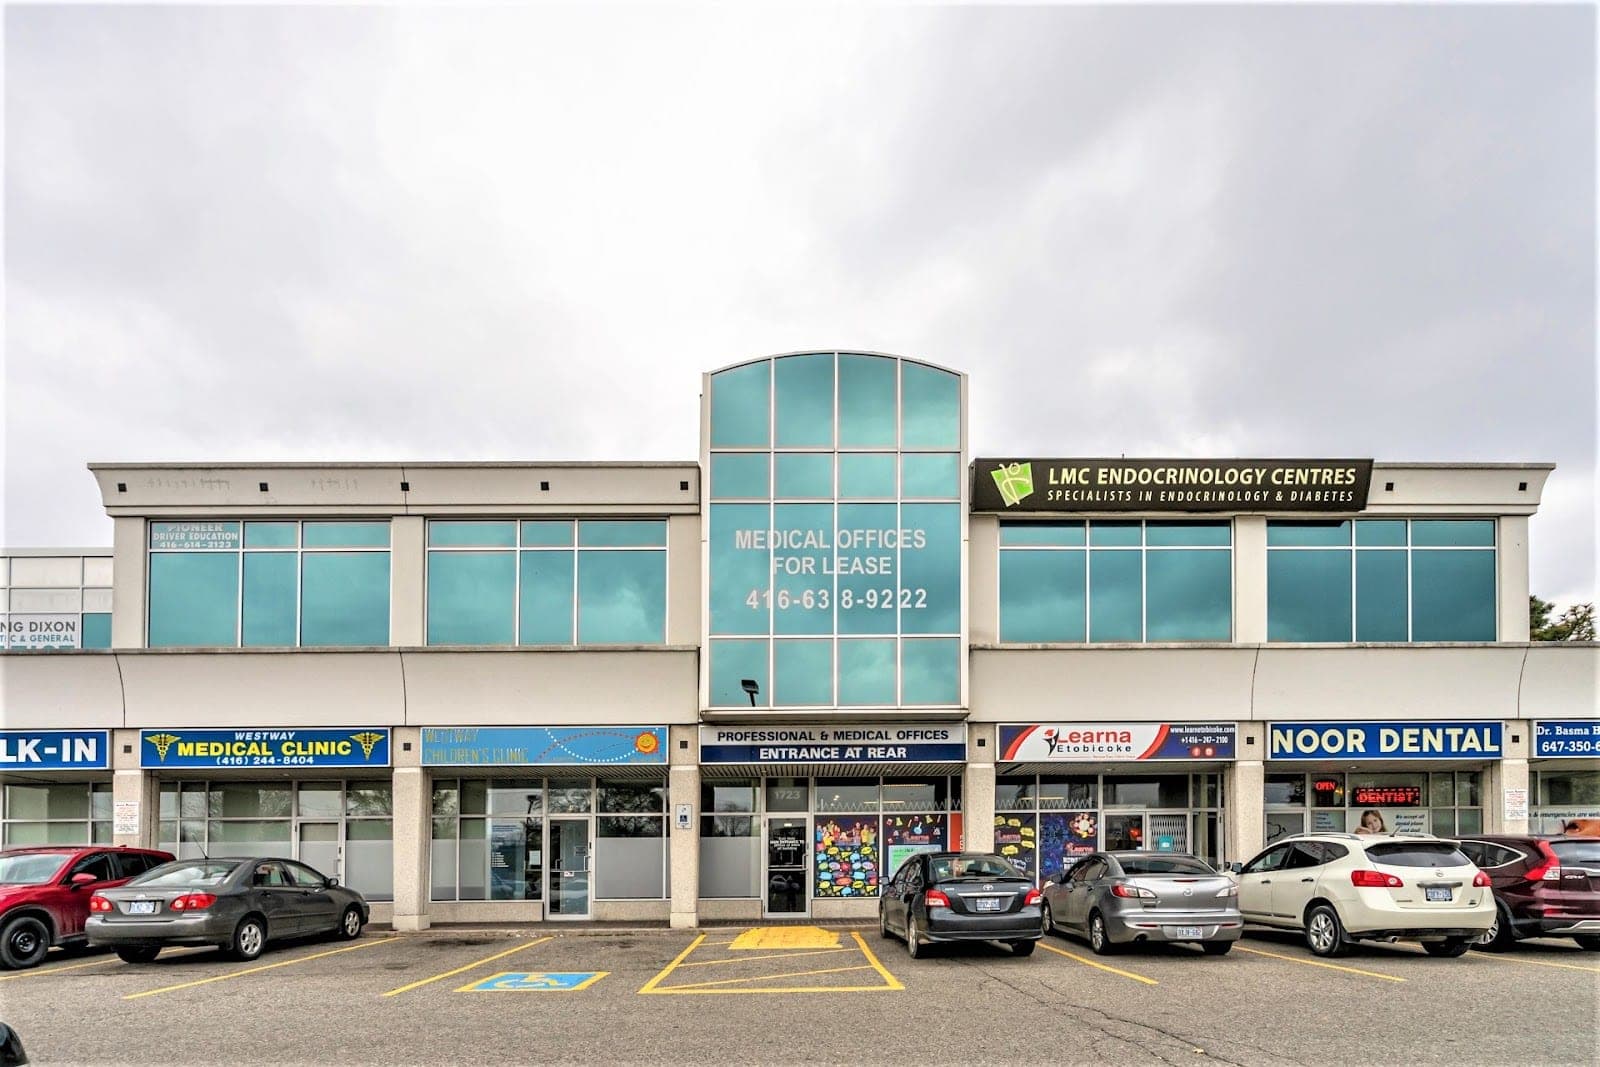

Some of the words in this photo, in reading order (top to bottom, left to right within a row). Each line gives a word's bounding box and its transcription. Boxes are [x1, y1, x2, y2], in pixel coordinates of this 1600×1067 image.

[1048, 468, 1090, 485] LMC
[1097, 467, 1267, 486] ENDOCRINOLOGY
[1271, 467, 1356, 485] CENTRES
[1047, 490, 1132, 501] SPECIALISTS
[1139, 491, 1152, 501] IN
[1160, 490, 1269, 502] ENDOCRINOLOGY
[1275, 491, 1283, 501] &
[1291, 490, 1354, 502] DIABETES
[153, 532, 186, 540] DRIVER
[190, 532, 239, 540] EDUCATION
[735, 530, 831, 549] MEDICAL
[837, 529, 927, 549] OFFICES
[773, 557, 816, 575] FOR
[823, 557, 892, 575] LEASE
[29, 621, 76, 633] DIXON
[30, 634, 75, 642] GENERAL
[234, 731, 296, 741] WESTWAY
[717, 731, 816, 742] PROFESSIONAL
[820, 731, 829, 741] &
[833, 730, 892, 741] MEDICAL
[896, 730, 949, 740] OFFICES
[1054, 729, 1131, 743] Learna
[1537, 725, 1552, 736] Dr.
[1554, 725, 1590, 736] Basma
[1271, 728, 1366, 753] NOOR
[1379, 727, 1500, 753] DENTAL
[0, 737, 97, 763] LK-IN
[177, 742, 273, 757] MEDICAL
[281, 741, 352, 756] CLINIC
[759, 747, 840, 760] ENTRANCE
[844, 747, 863, 759] AT
[867, 747, 907, 759] REAR
[1057, 744, 1132, 753] Etobicoke
[216, 756, 249, 766] (416)
[253, 756, 314, 766] 244-8404
[425, 747, 489, 763] CHILDREN'S
[492, 747, 529, 763] CLINIC
[1315, 781, 1336, 791] OPEN
[1358, 791, 1415, 803] DENTIST
